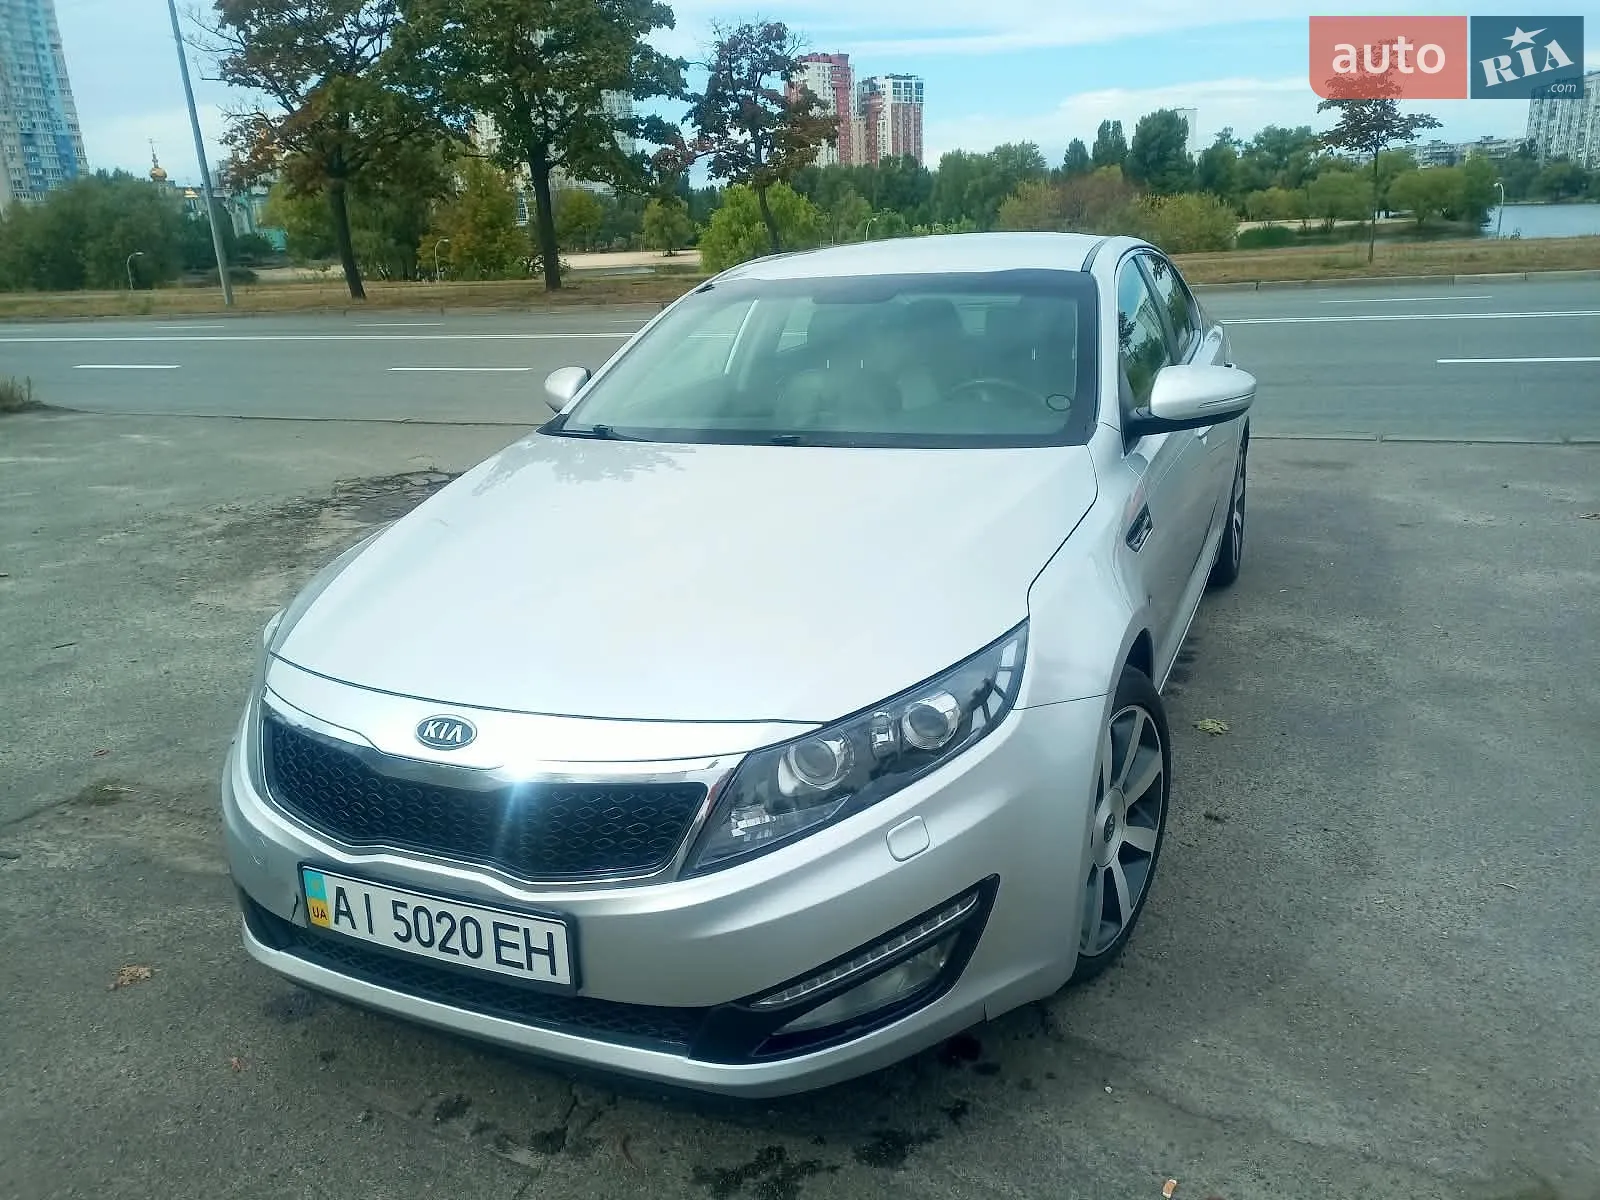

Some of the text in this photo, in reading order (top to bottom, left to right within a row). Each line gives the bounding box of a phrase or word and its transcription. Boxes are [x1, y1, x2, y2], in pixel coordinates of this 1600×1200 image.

[423, 720, 463, 743] KIA
[312, 907, 328, 921] UA
[333, 886, 557, 976] AI 5020 EH
